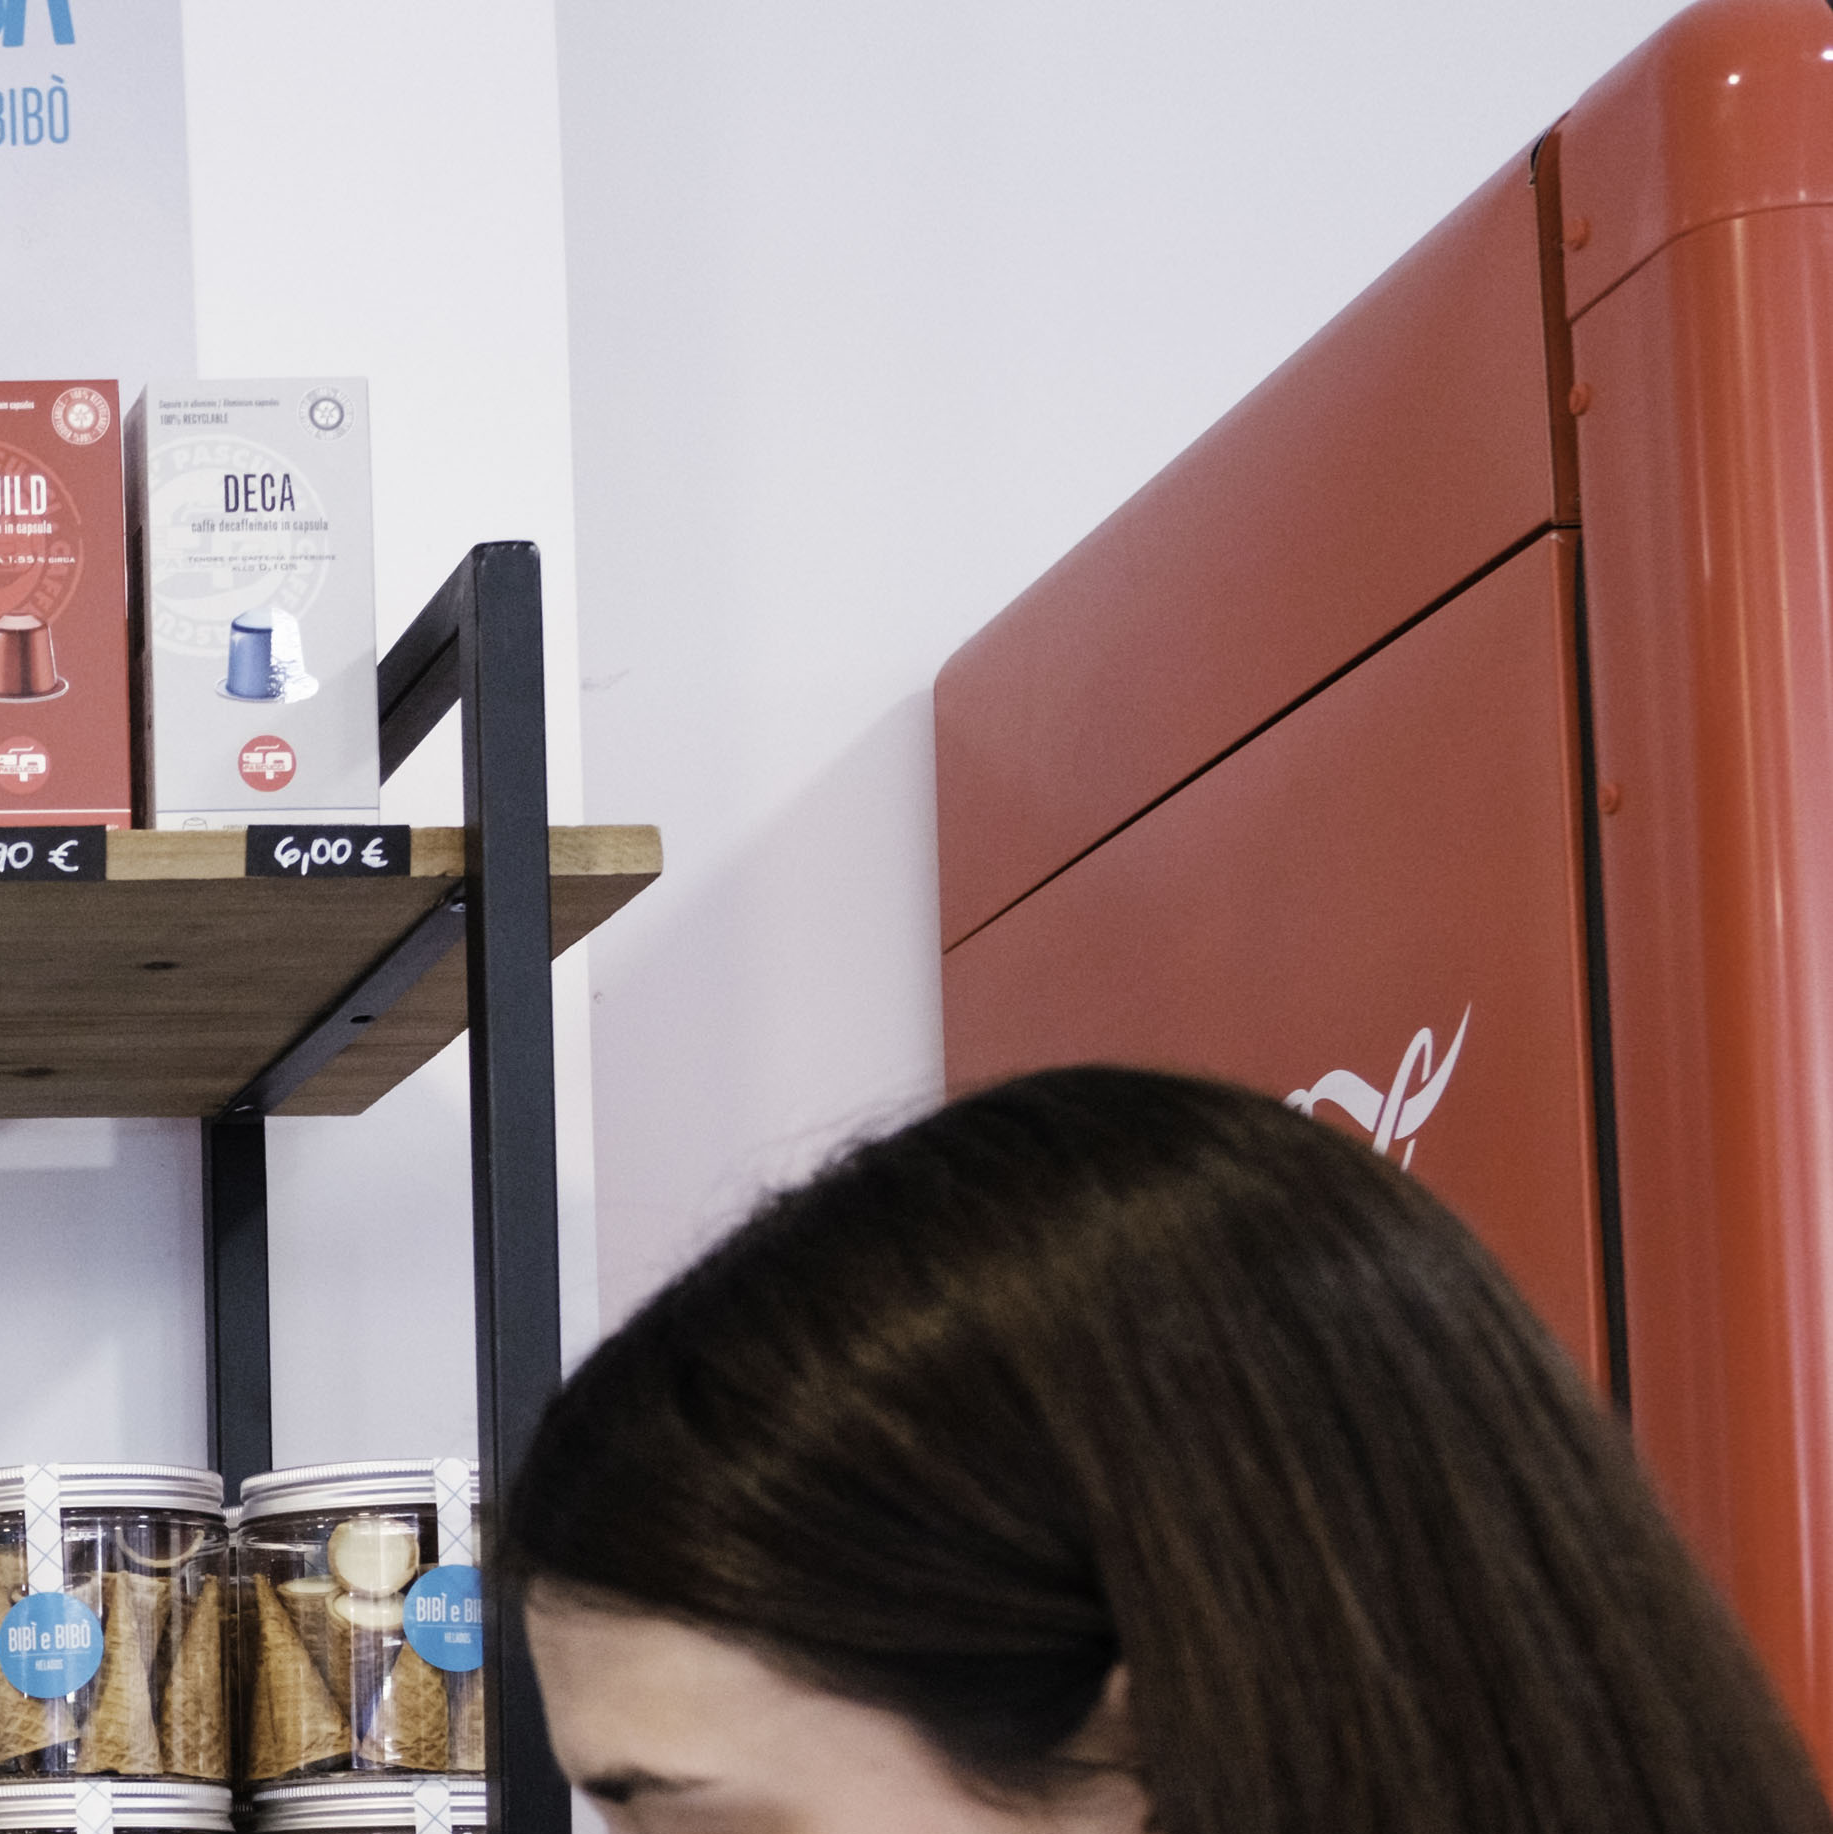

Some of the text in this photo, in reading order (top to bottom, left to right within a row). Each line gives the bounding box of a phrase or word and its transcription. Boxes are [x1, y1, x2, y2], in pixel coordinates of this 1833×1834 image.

[224, 473, 296, 513] DECA
[5, 521, 14, 534] in
[16, 519, 53, 537] capsula
[48, 839, 80, 873] €
[8, 1619, 91, 1652] BIBÌ e BIBÒ
